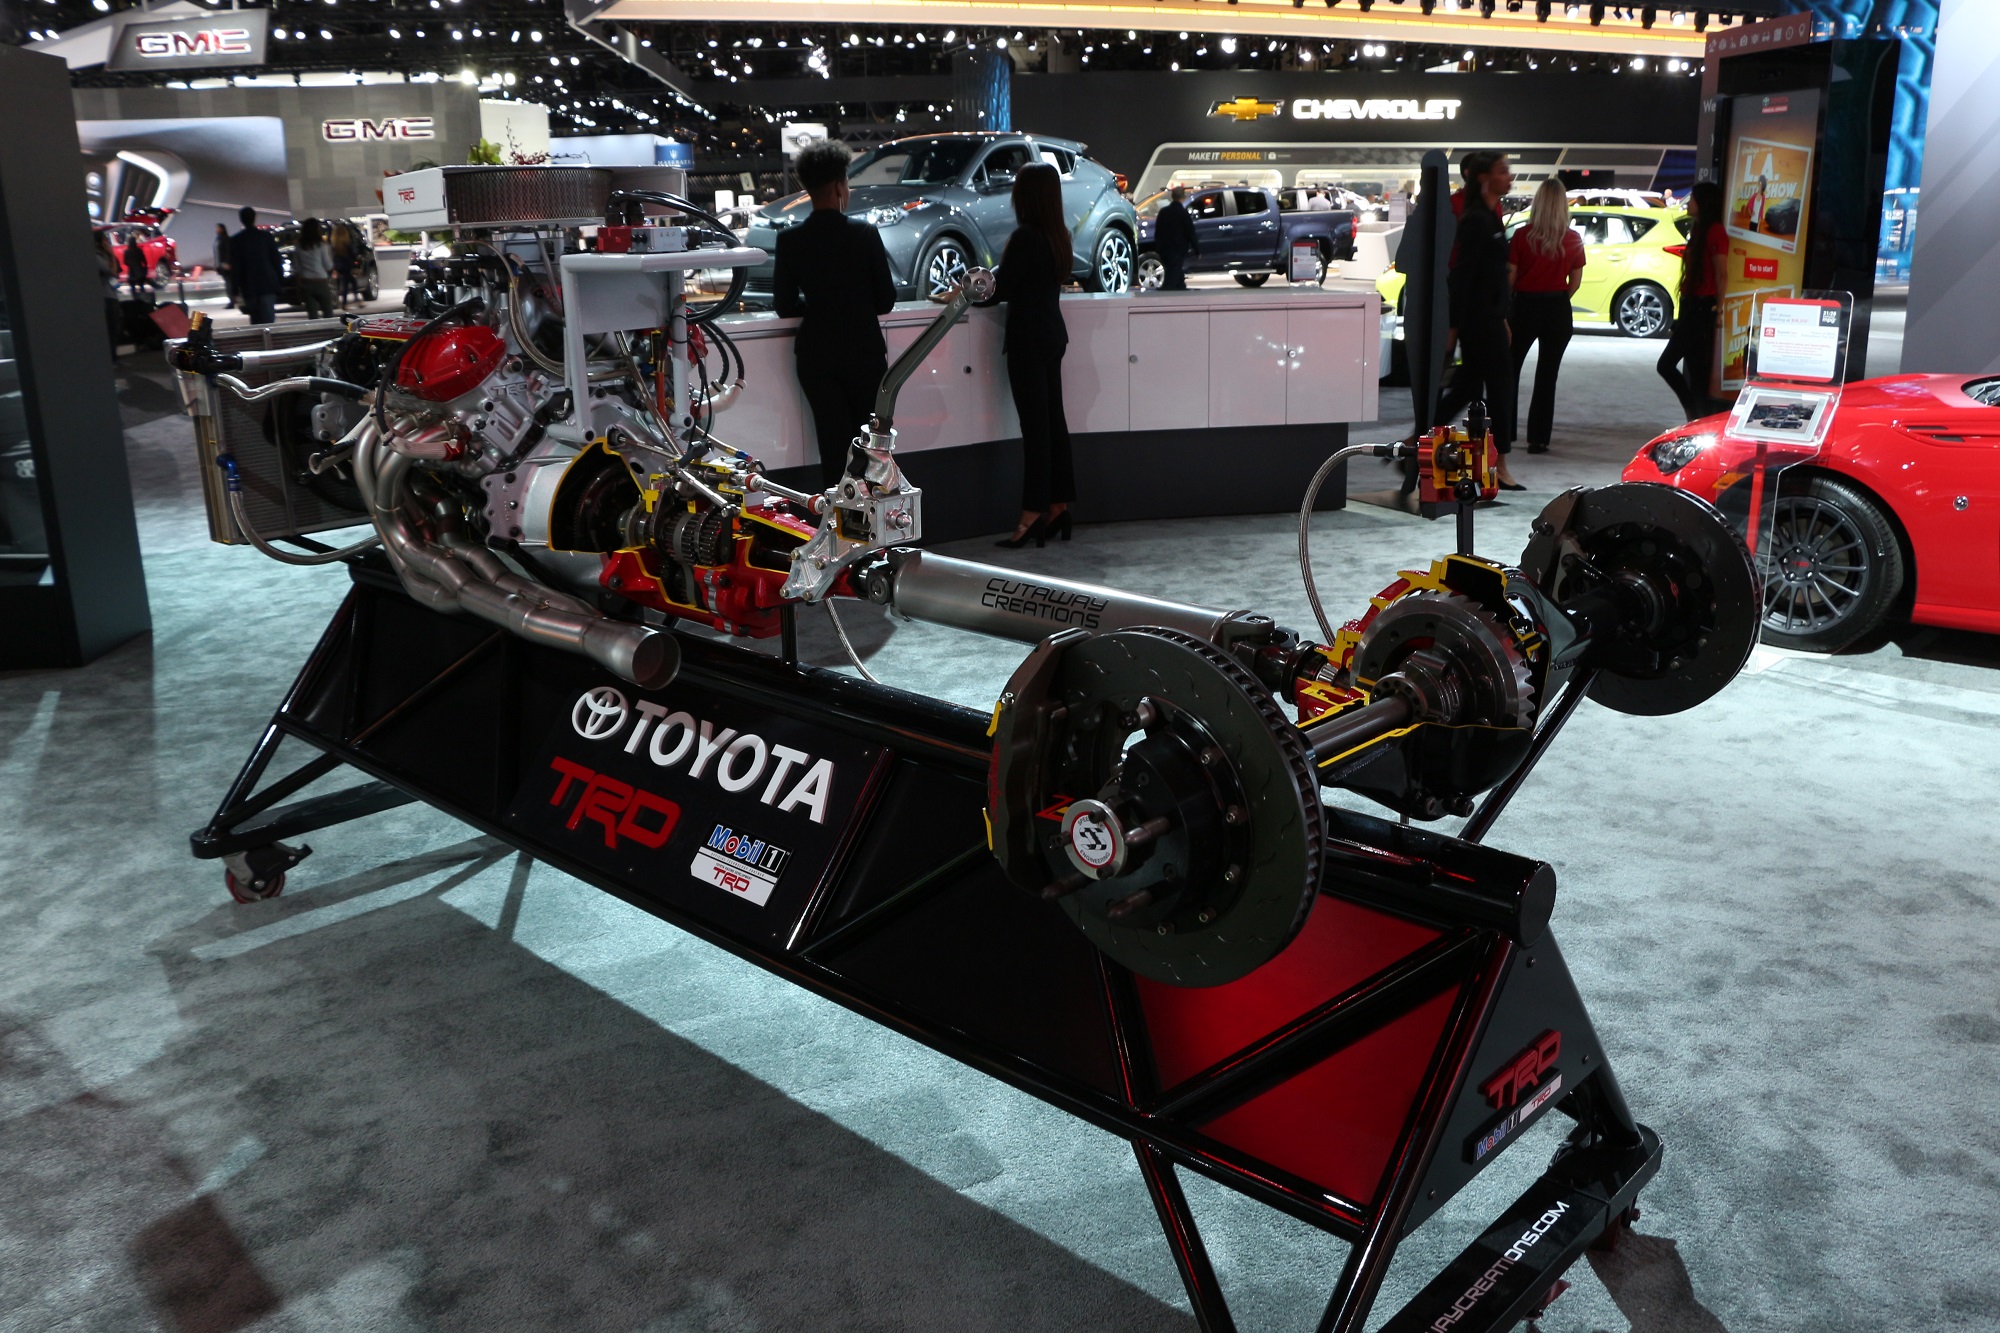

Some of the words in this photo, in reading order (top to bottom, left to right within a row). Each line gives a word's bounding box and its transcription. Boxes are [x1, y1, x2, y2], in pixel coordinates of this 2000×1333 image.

[136, 28, 251, 58] GMC
[1292, 99, 1461, 120] CHEVROLET
[322, 116, 435, 142] GMC
[1188, 152, 1211, 160] MAKE
[1211, 152, 1220, 160] IT
[1220, 152, 1261, 160] PERSONAL
[398, 190, 415, 204] TRD
[1738, 185, 1759, 200] AUT
[1765, 182, 1798, 199] SHOW
[1749, 263, 1757, 272] Tap
[1762, 265, 1773, 273] start
[986, 578, 1109, 613] CUTAWAY
[981, 592, 1101, 629] CREATIONS
[623, 699, 835, 825] TOYOTA
[550, 755, 682, 849] TRD
[707, 824, 766, 865] Mobil
[1079, 849, 1110, 864] ENGINEERING
[713, 866, 750, 892] TRD
[748, 868, 765, 877] PARTNER
[1486, 1029, 1562, 1110] TRD
[1477, 1119, 1508, 1161] Mobil
[1531, 1087, 1552, 1108] TRD
